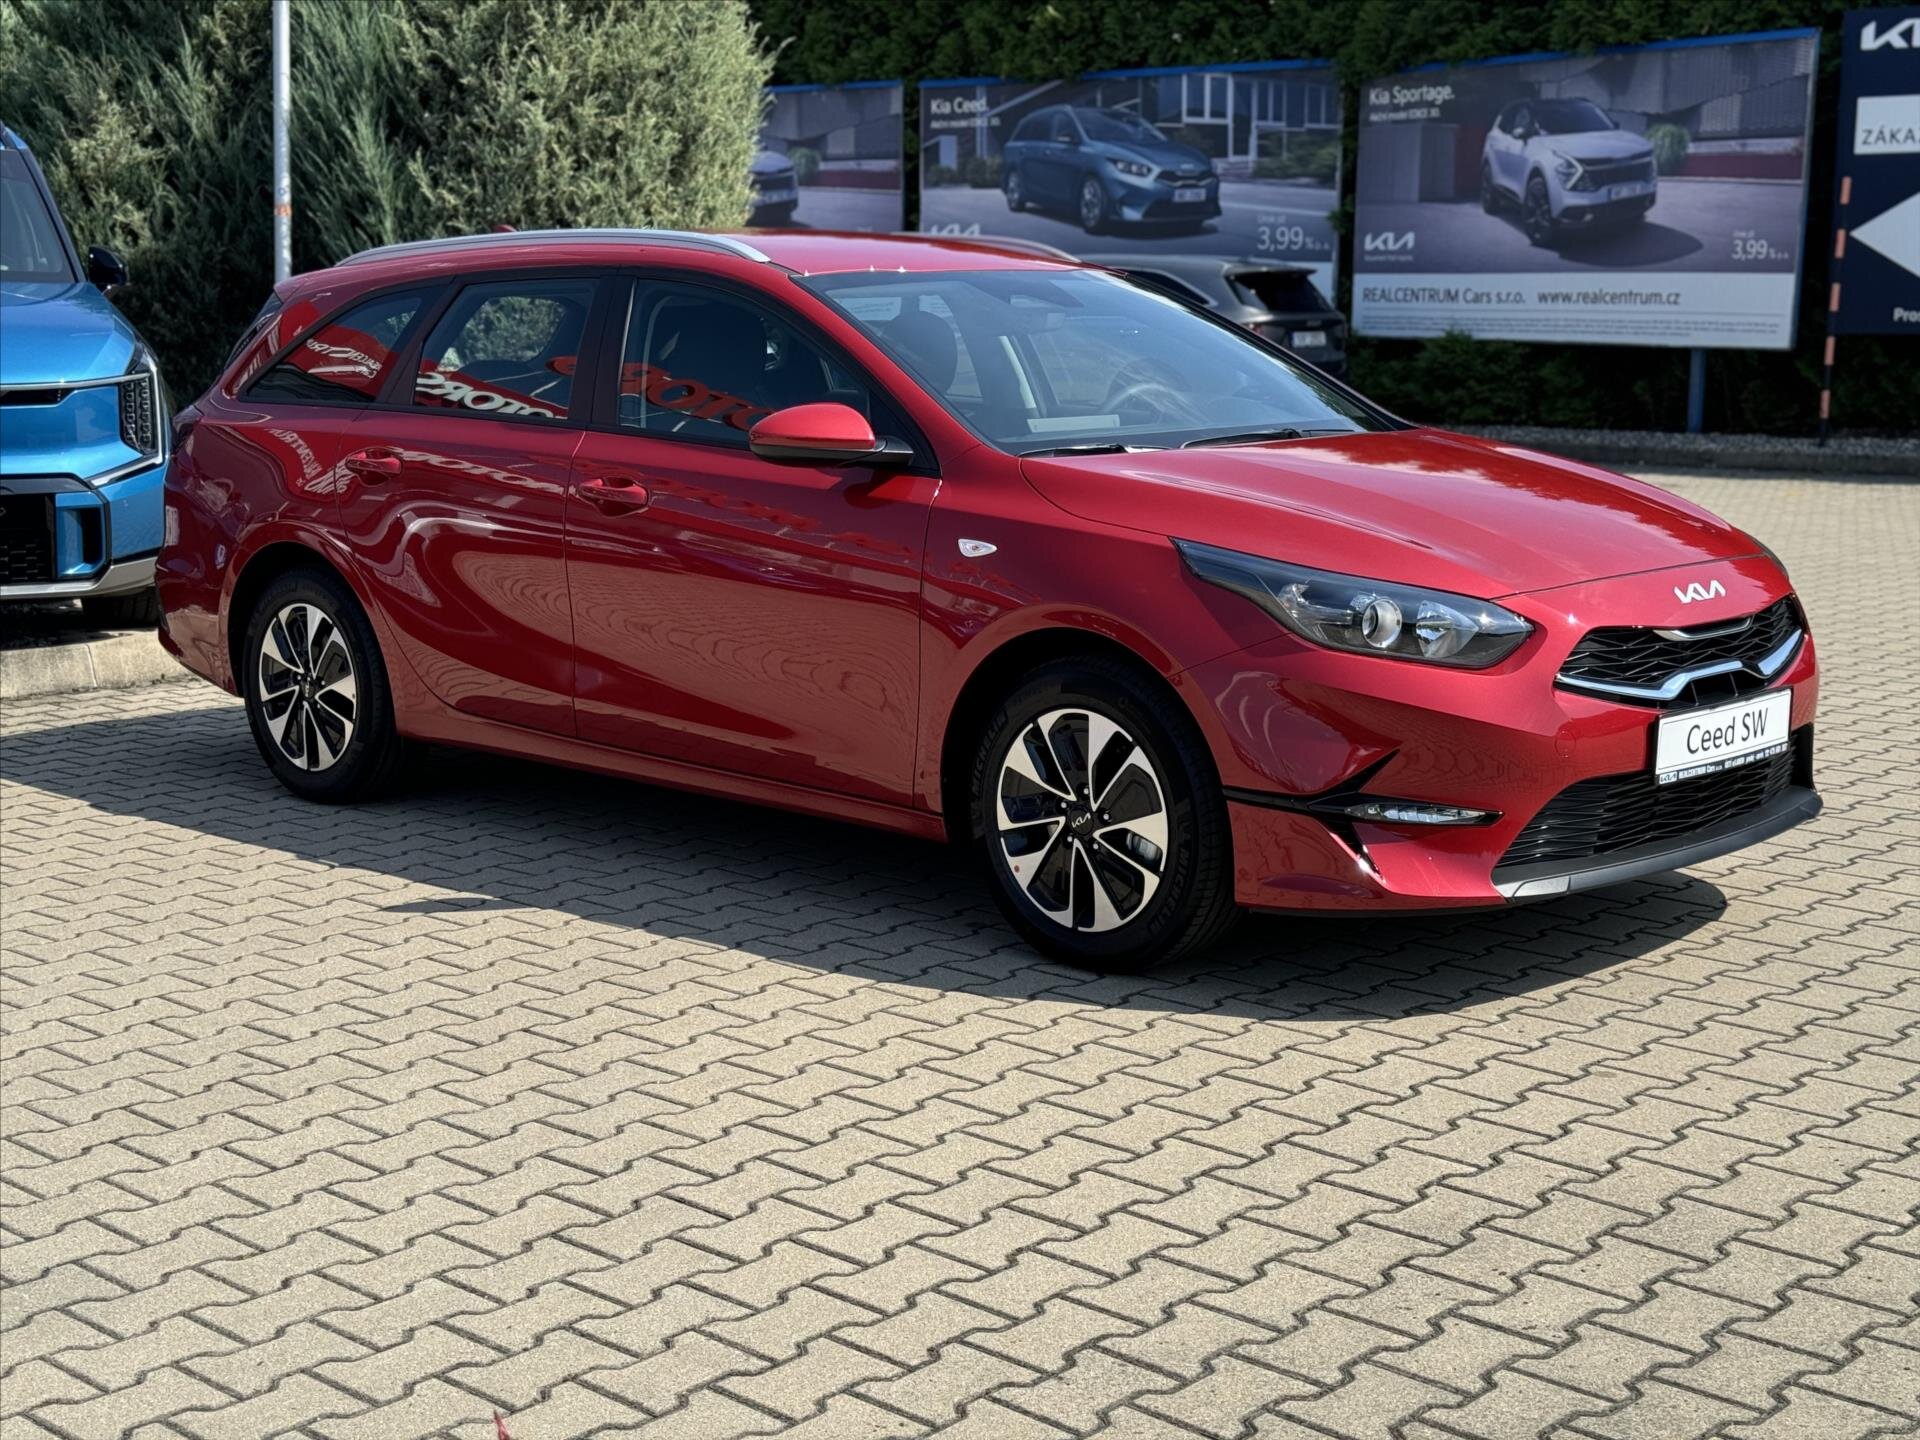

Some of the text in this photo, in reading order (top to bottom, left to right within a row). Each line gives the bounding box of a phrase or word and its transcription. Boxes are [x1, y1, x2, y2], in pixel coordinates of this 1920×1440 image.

[931, 98, 951, 114] Kia
[1369, 85, 1455, 107] Kia Sportage.
[1861, 124, 1920, 145] ZÁKA
[1257, 226, 1304, 252] 3,99
[1364, 231, 1415, 251] KIA
[1731, 239, 1768, 260] 3,99
[1363, 287, 1681, 305] REALCENTRUM Cars s.r.o. www.realcentrum.cz
[1674, 579, 1726, 604] KIA
[1687, 707, 1768, 754] Ceed SW
[1071, 812, 1091, 828] KIA
